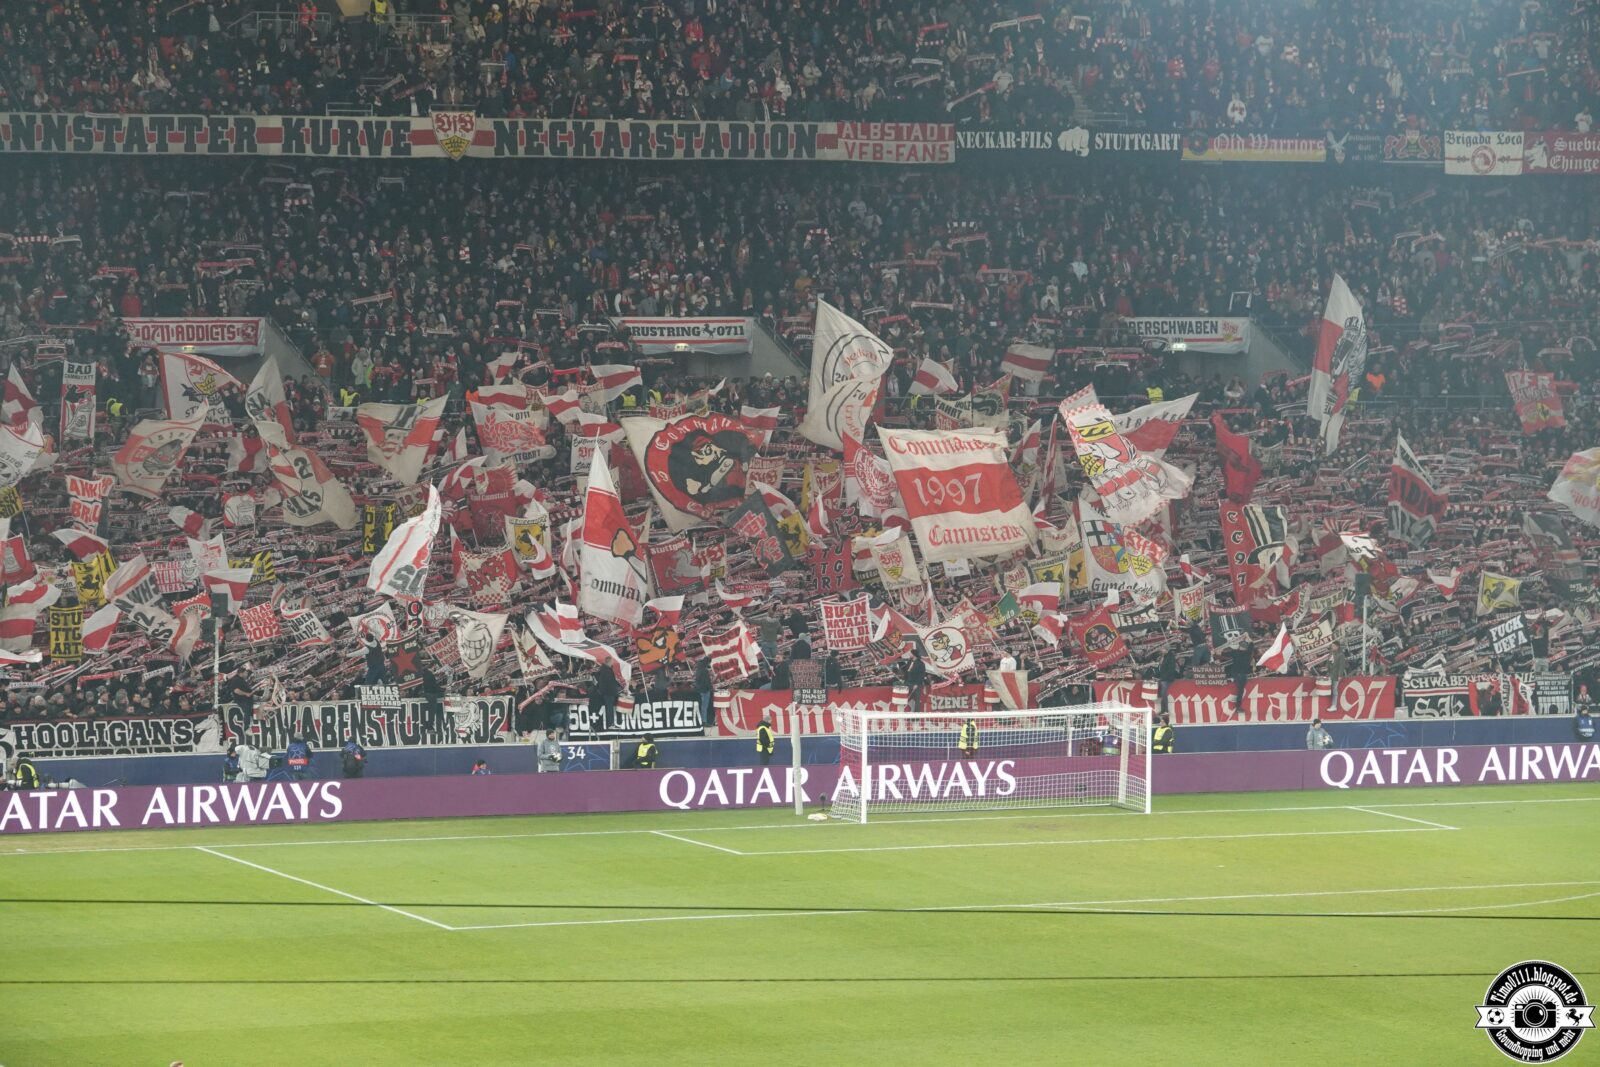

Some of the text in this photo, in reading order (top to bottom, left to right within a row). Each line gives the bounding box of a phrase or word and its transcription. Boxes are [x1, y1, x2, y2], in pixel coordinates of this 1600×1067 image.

[282, 116, 412, 156] KURVE
[493, 119, 818, 159] NECKARSTADION
[841, 122, 955, 141] ALBSTADT
[956, 130, 1181, 152] NECKAR-FILS STUTTGART
[1496, 132, 1523, 146] Loca
[844, 141, 950, 162] VFB-FANS
[1213, 132, 1327, 155] Old Warriors
[175, 323, 236, 342] ADDICTS
[716, 325, 745, 336] 0711
[1125, 320, 1219, 336] BERSCHWABEN
[67, 363, 92, 375] BAD
[912, 470, 983, 507] 1997
[51, 611, 83, 626] STU
[826, 616, 868, 630] NATALE
[51, 627, 82, 642] TTG
[247, 623, 281, 643] 2002
[828, 625, 870, 640] FIGLI DI
[1489, 614, 1524, 643] FUCK
[51, 642, 82, 655] ART
[828, 636, 871, 648] PUTTANA
[1493, 629, 1528, 655] UEFA
[360, 685, 400, 696] ULTRAS
[1401, 673, 1469, 689] SCHWABE
[930, 695, 969, 711] SZENE
[1339, 681, 1388, 720] 97
[478, 699, 506, 743] 02
[568, 700, 703, 731] 50+1 UMSETZEN
[13, 718, 194, 750] HOOLIGANS
[288, 758, 306, 766] PHOTO
[567, 746, 586, 760] 34
[1319, 747, 1461, 789] QATAR
[659, 759, 1017, 810] QATAR AIRWAYS
[141, 780, 343, 826] AIRWAYS
